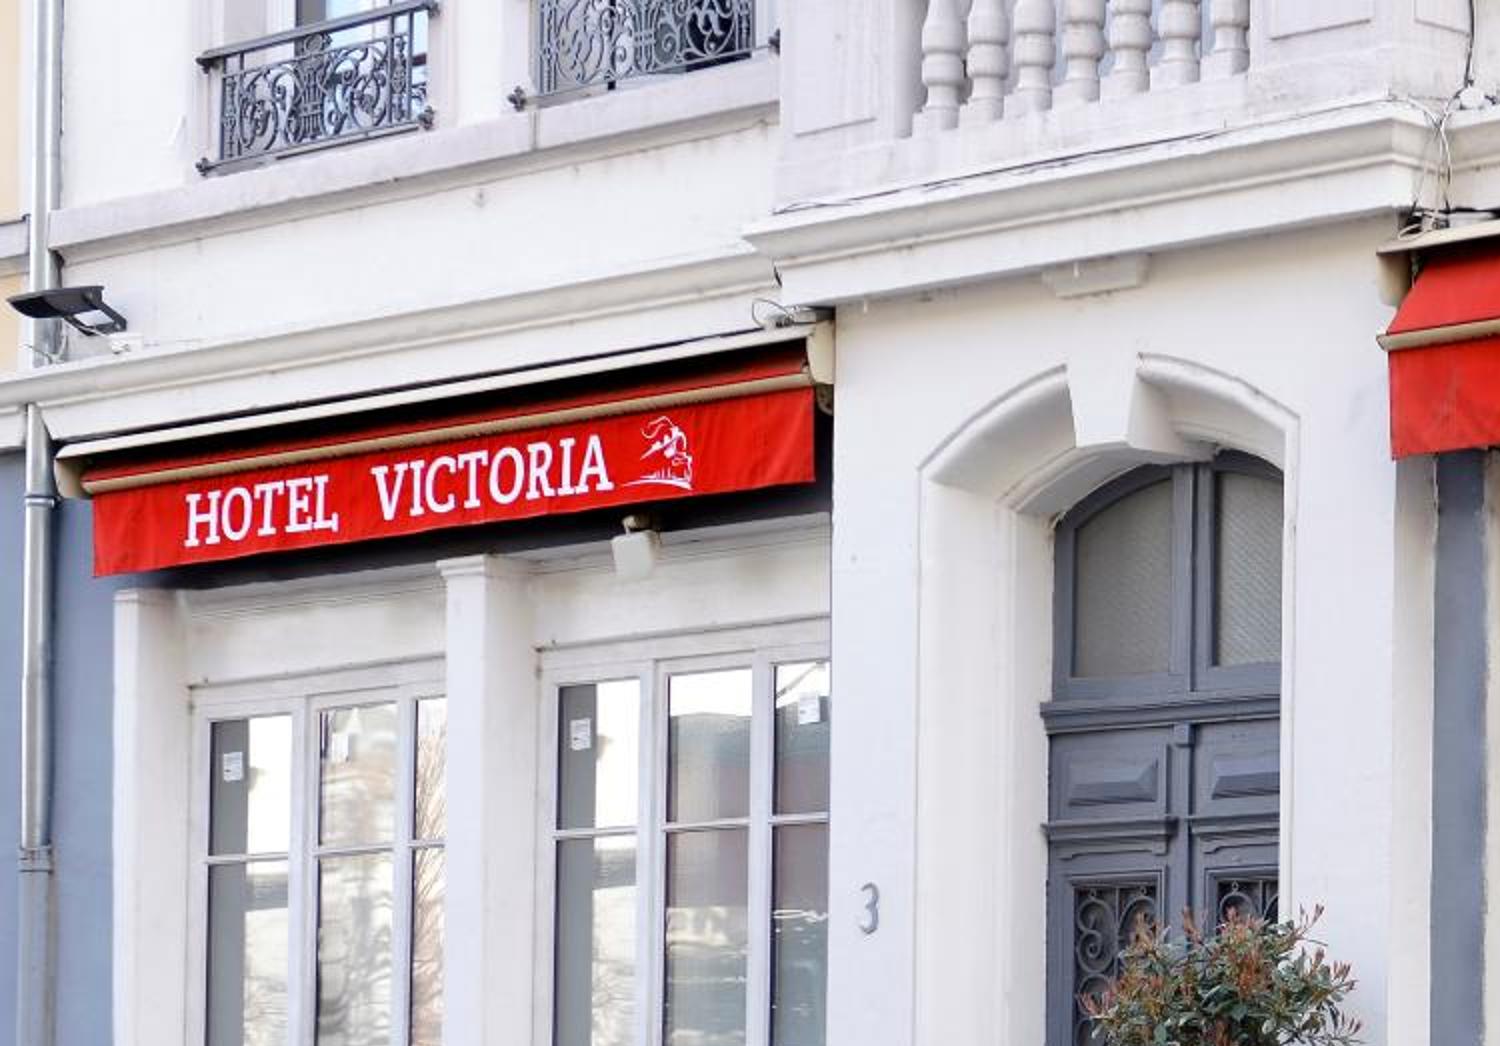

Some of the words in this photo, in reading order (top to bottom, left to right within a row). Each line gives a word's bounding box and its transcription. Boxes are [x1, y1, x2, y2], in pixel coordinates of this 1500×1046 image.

[184, 475, 341, 548] HOTEL
[371, 434, 615, 521] VICTORIA
[859, 882, 880, 935] 3
